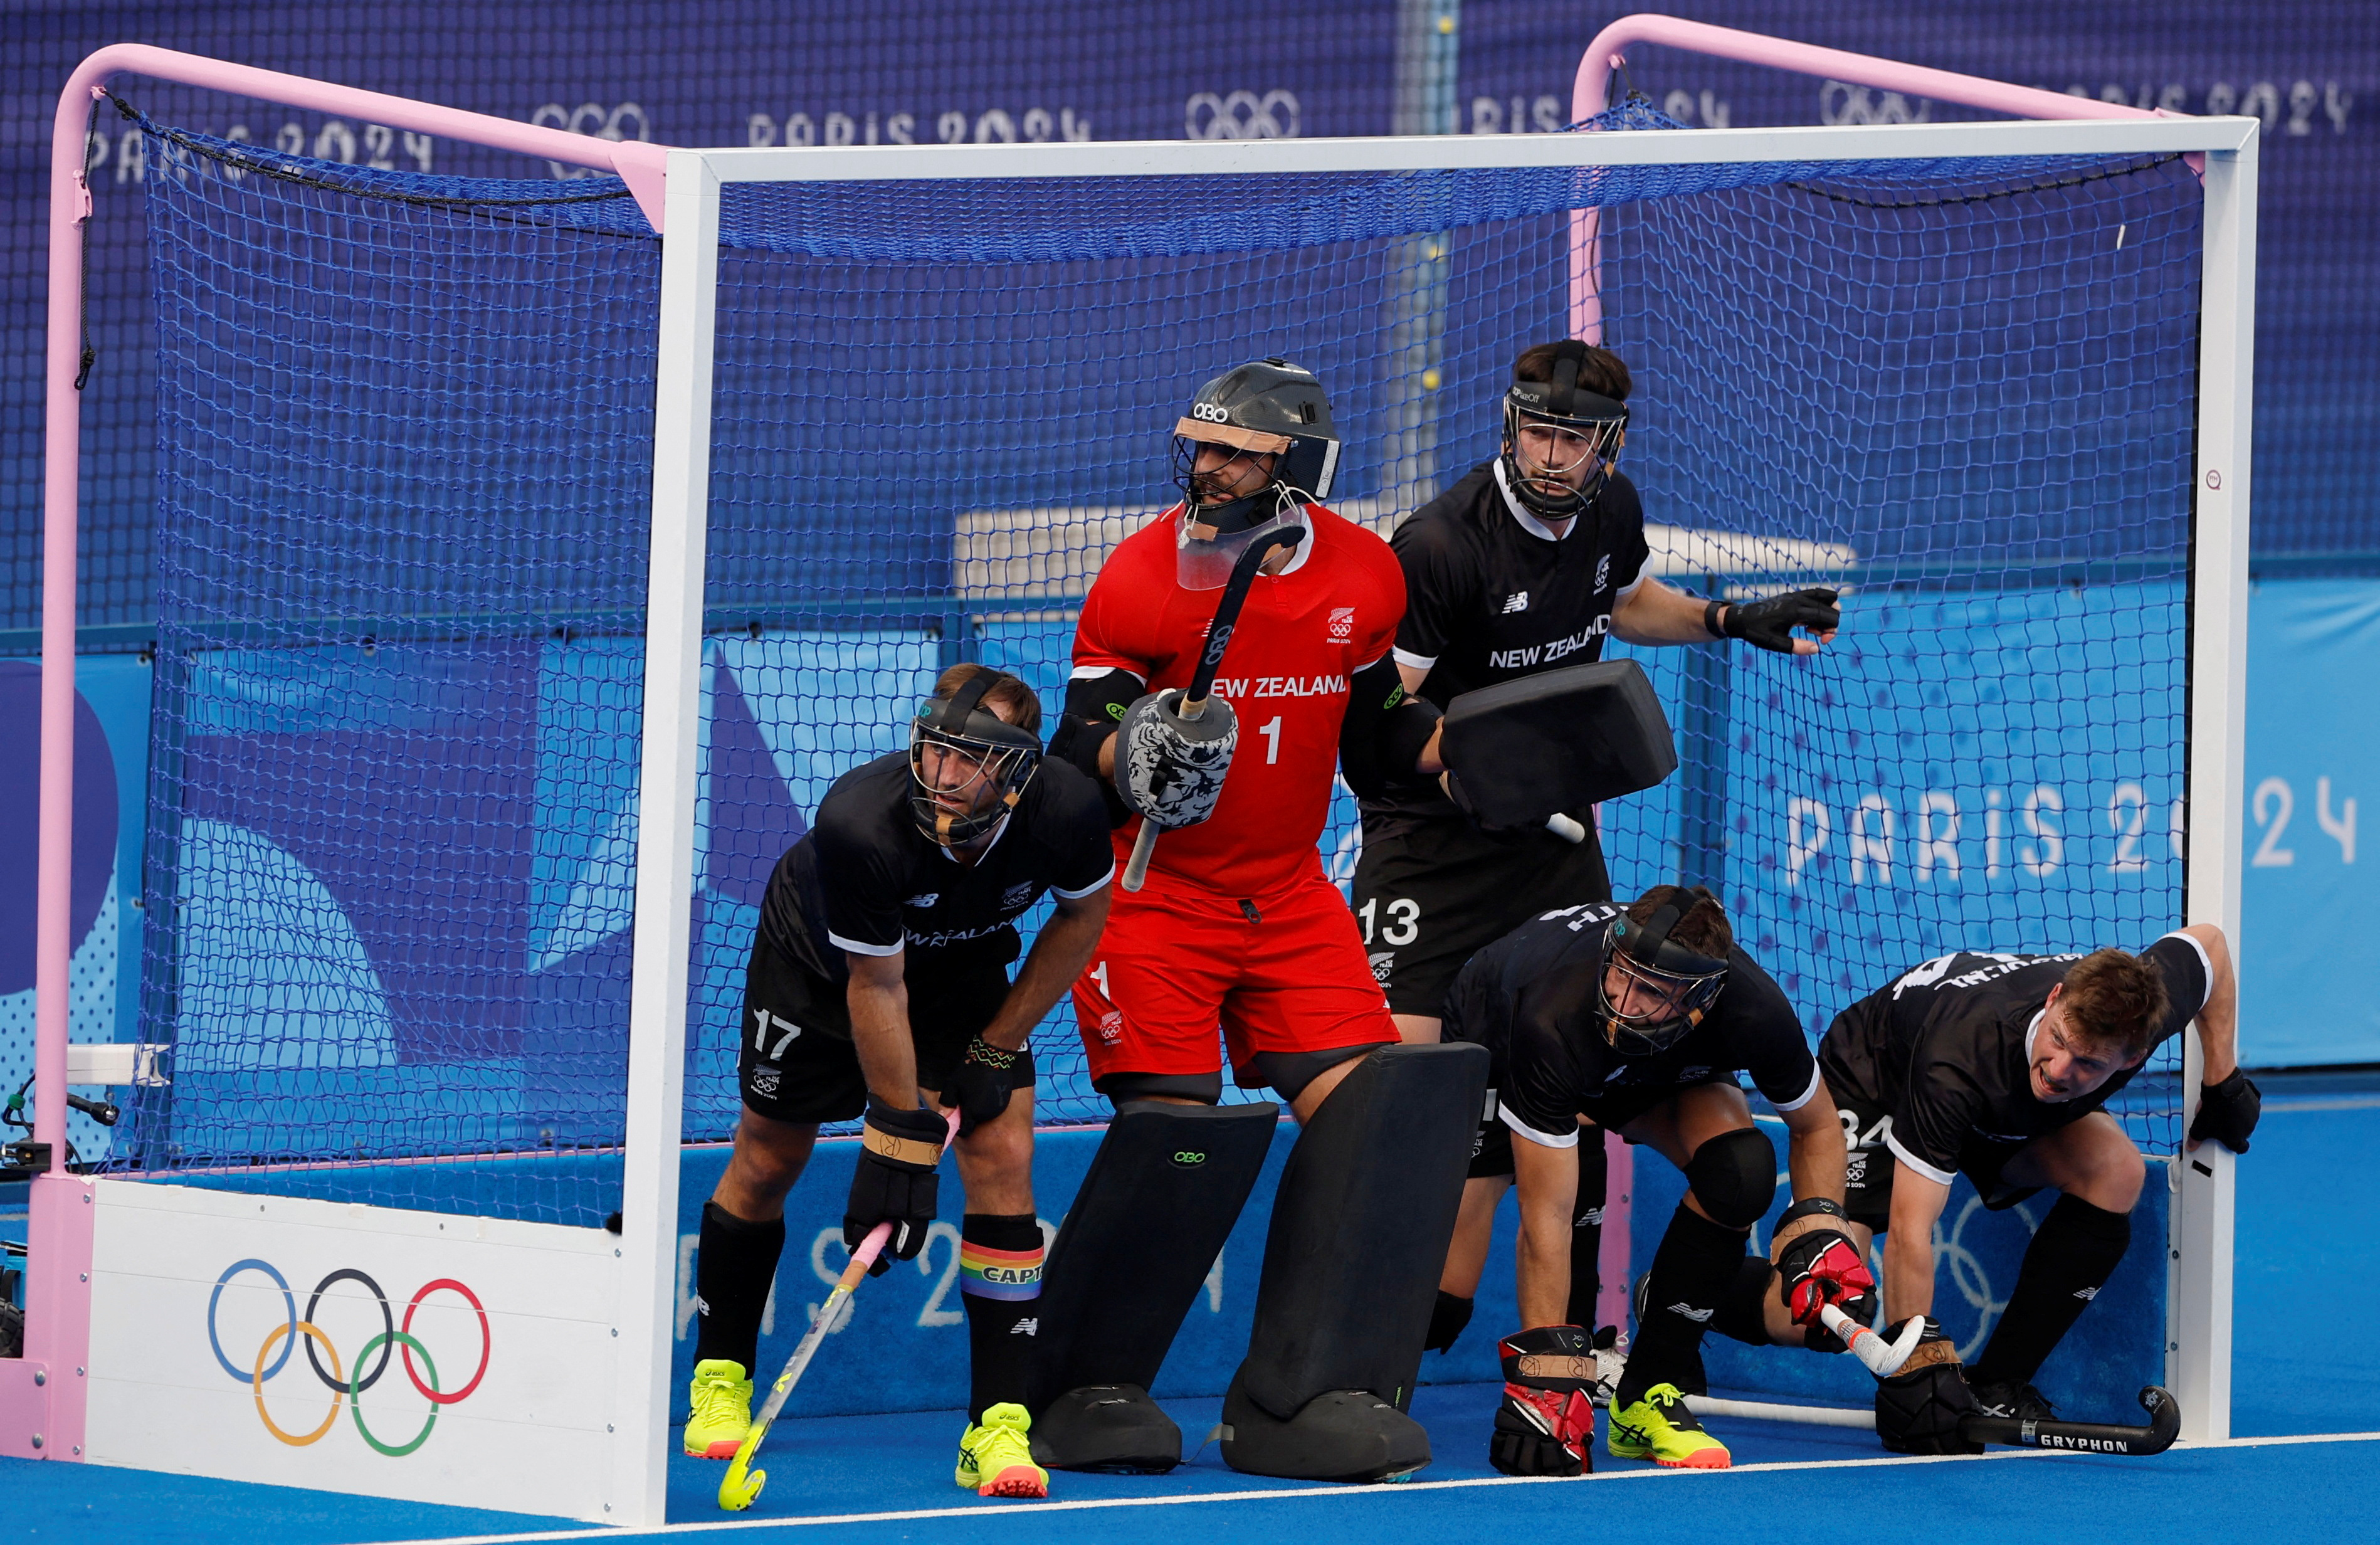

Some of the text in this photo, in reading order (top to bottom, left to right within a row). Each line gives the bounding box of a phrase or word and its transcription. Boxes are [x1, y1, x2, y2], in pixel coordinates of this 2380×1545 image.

[1194, 403, 1228, 423] OBO
[1205, 625, 1233, 665] OBO
[1489, 645, 1541, 668] NEW
[1210, 678, 1249, 698] EW
[1386, 685, 1402, 707] OBO
[1109, 705, 1125, 719] OB
[1259, 715, 1282, 764] 1
[1359, 898, 1420, 946] 13
[1090, 961, 1110, 1001] 1
[754, 1008, 801, 1061] 17
[1174, 1151, 1205, 1163] OBO
[982, 1265, 1043, 1284] CAPT
[2040, 1434, 2128, 1453] GRYPHON
